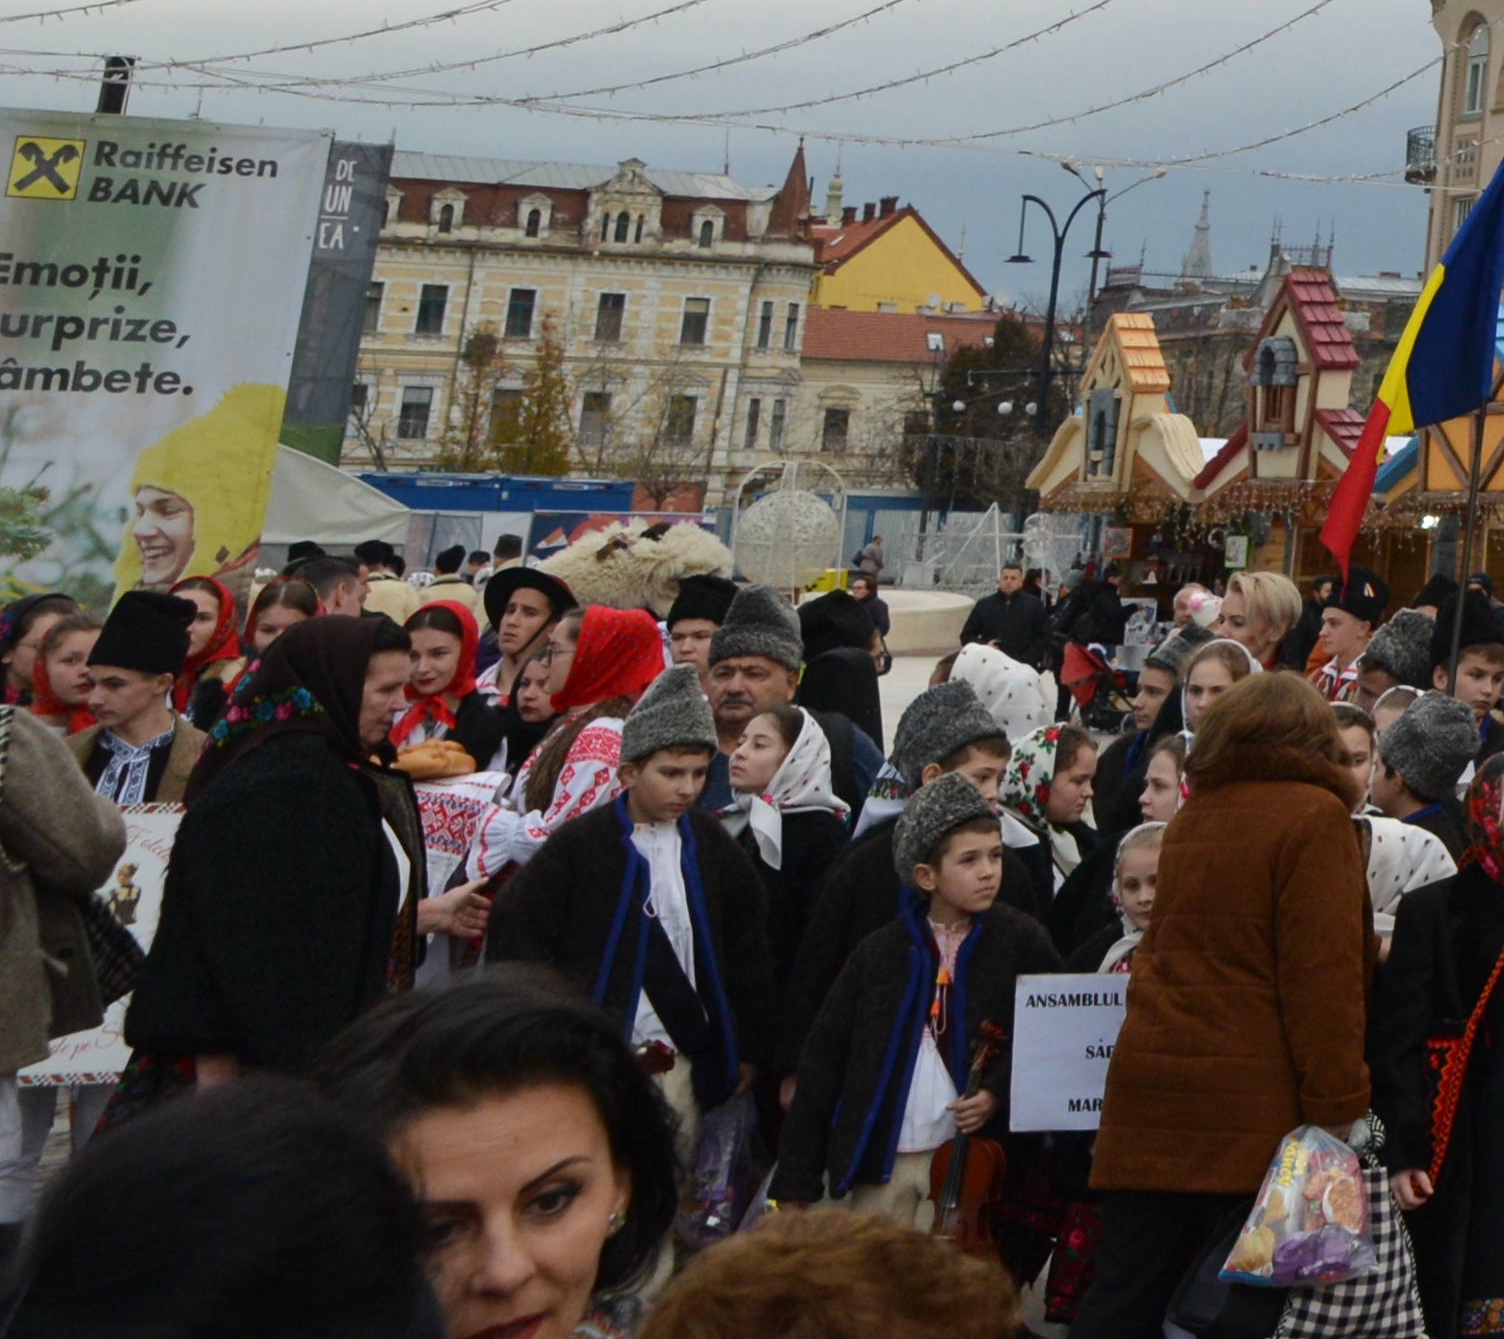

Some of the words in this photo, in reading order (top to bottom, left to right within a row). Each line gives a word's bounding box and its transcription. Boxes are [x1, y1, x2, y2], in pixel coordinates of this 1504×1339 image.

[94, 140, 279, 179] Raiffeisen
[87, 176, 207, 209] BANK
[0, 305, 191, 349] urprize,
[0, 357, 194, 396] âmbete.
[1025, 992, 1124, 1008] ANSAMBLUL
[1068, 1098, 1103, 1113] MAR
